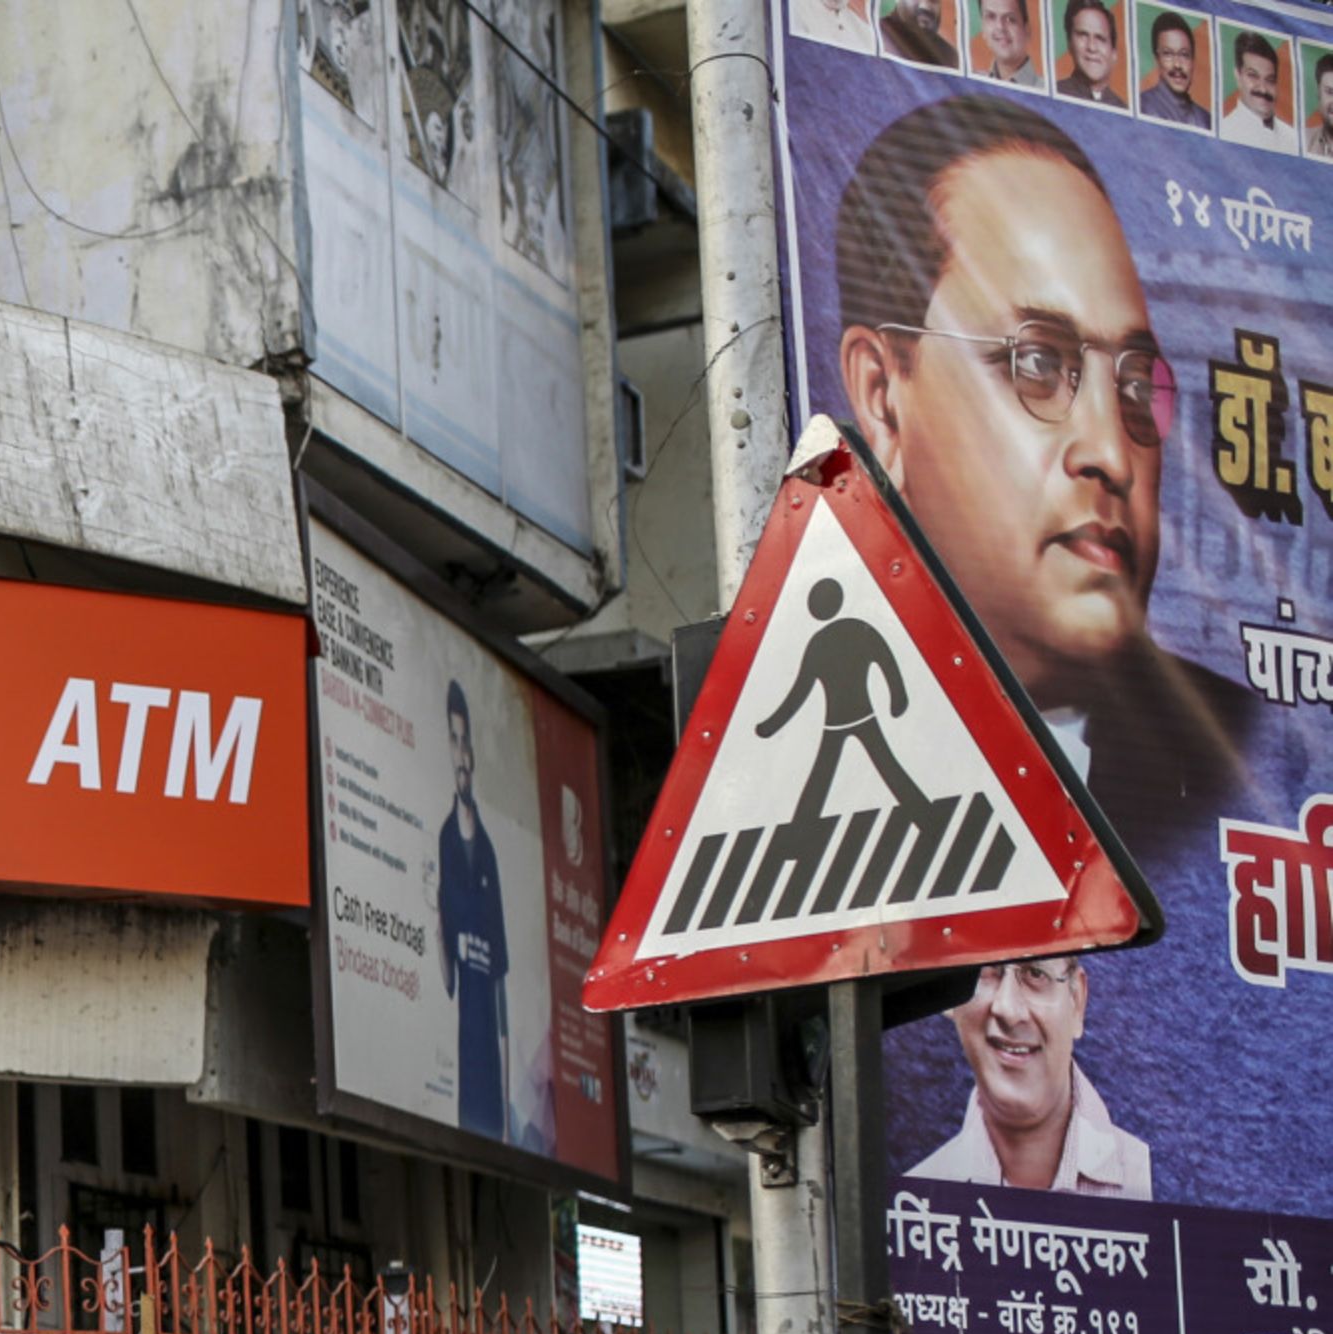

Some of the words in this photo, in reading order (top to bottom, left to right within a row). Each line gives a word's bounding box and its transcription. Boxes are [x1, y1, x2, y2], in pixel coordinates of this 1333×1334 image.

[1165, 180, 1211, 229] १४
[1220, 186, 1314, 252] एप्रिल
[27, 677, 263, 805] ATM
[1243, 1238, 1318, 1312] सौ.
